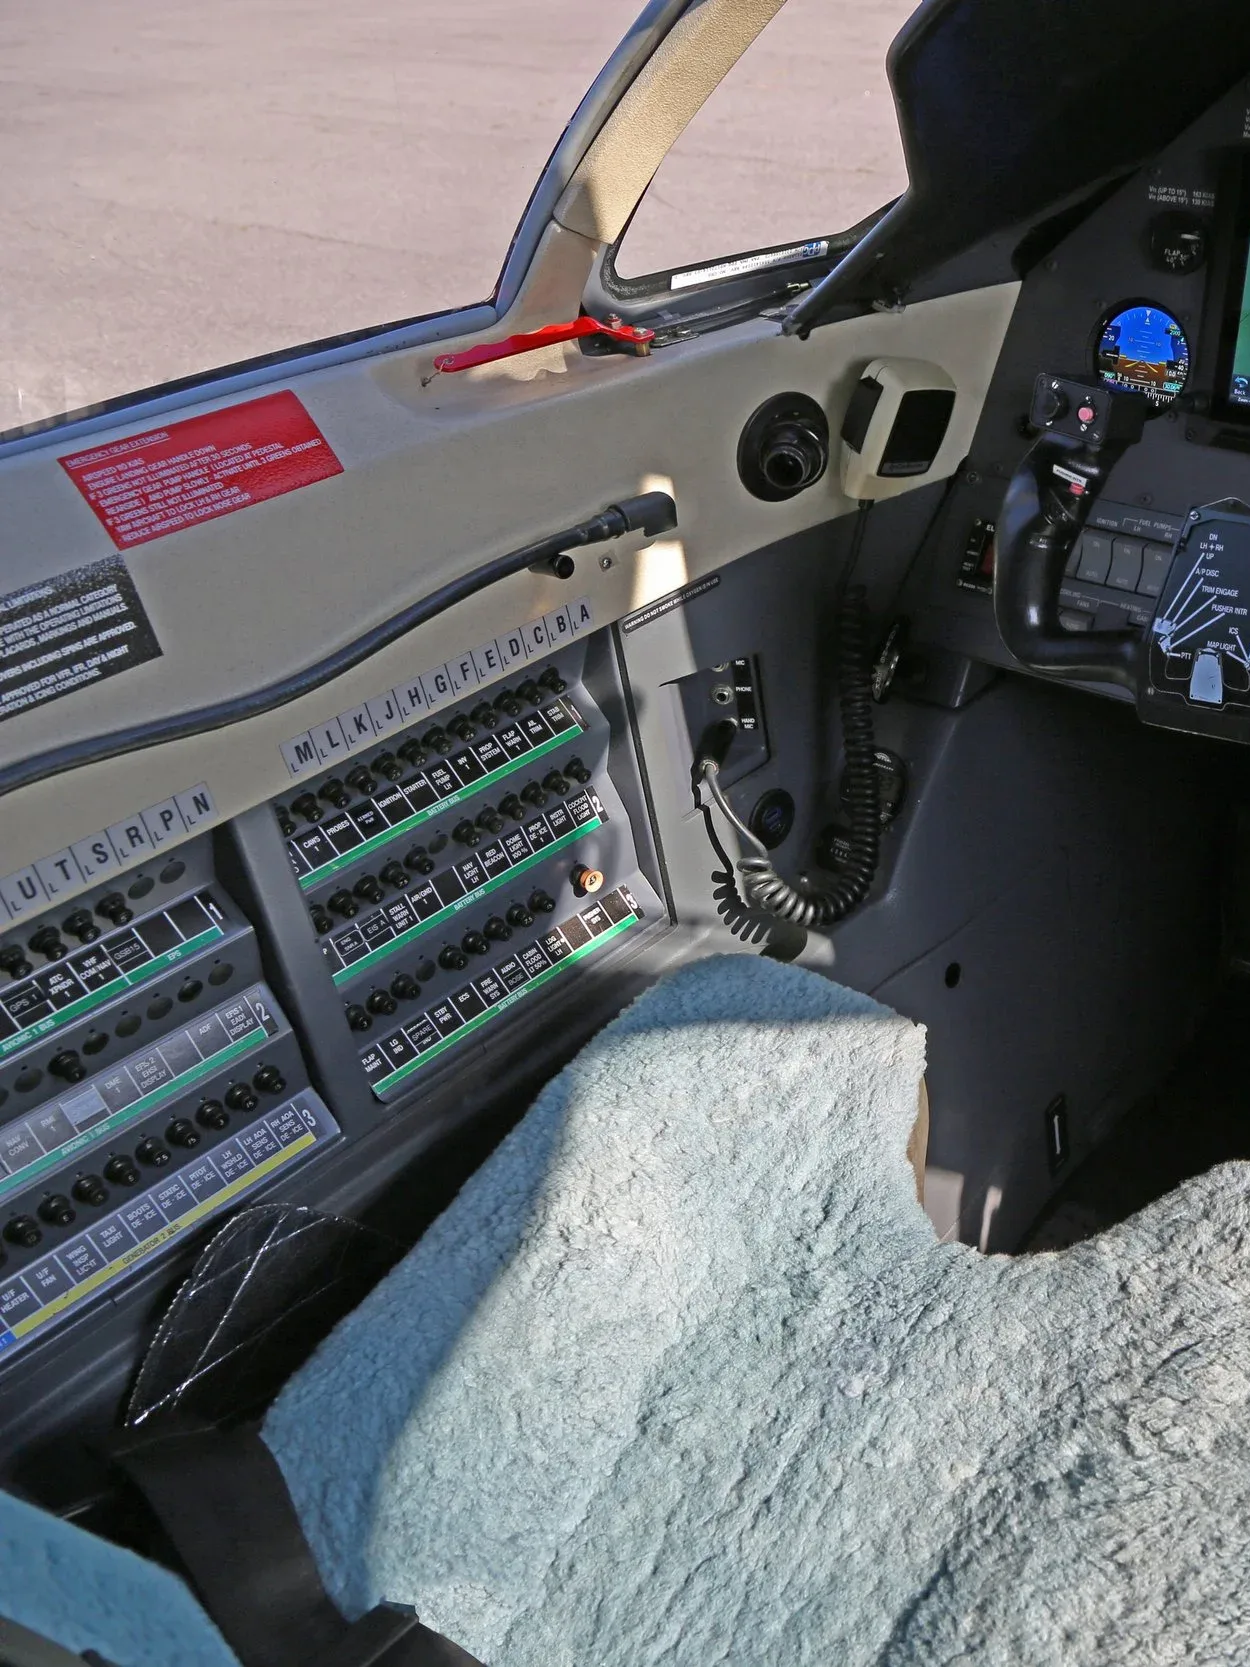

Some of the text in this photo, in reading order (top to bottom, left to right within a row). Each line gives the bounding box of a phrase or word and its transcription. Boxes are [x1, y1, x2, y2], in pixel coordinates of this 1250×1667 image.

[1202, 585, 1239, 597] TRIM ENGAGE
[1211, 604, 1248, 615] PUSHER INTR
[624, 614, 644, 629] WARNING
[1206, 640, 1236, 651] MAP LIGHT
[294, 603, 590, 764] M L K J H G F E D C B A
[403, 779, 427, 796] STARTER
[377, 792, 402, 809] IGNITION
[568, 795, 588, 811] COCKPIT
[572, 802, 589, 815] FLOOD
[326, 820, 350, 836] PROBES
[17, 792, 210, 900] U T S R P N
[189, 1164, 207, 1180] PITOT
[127, 1203, 150, 1219] BOOTS
